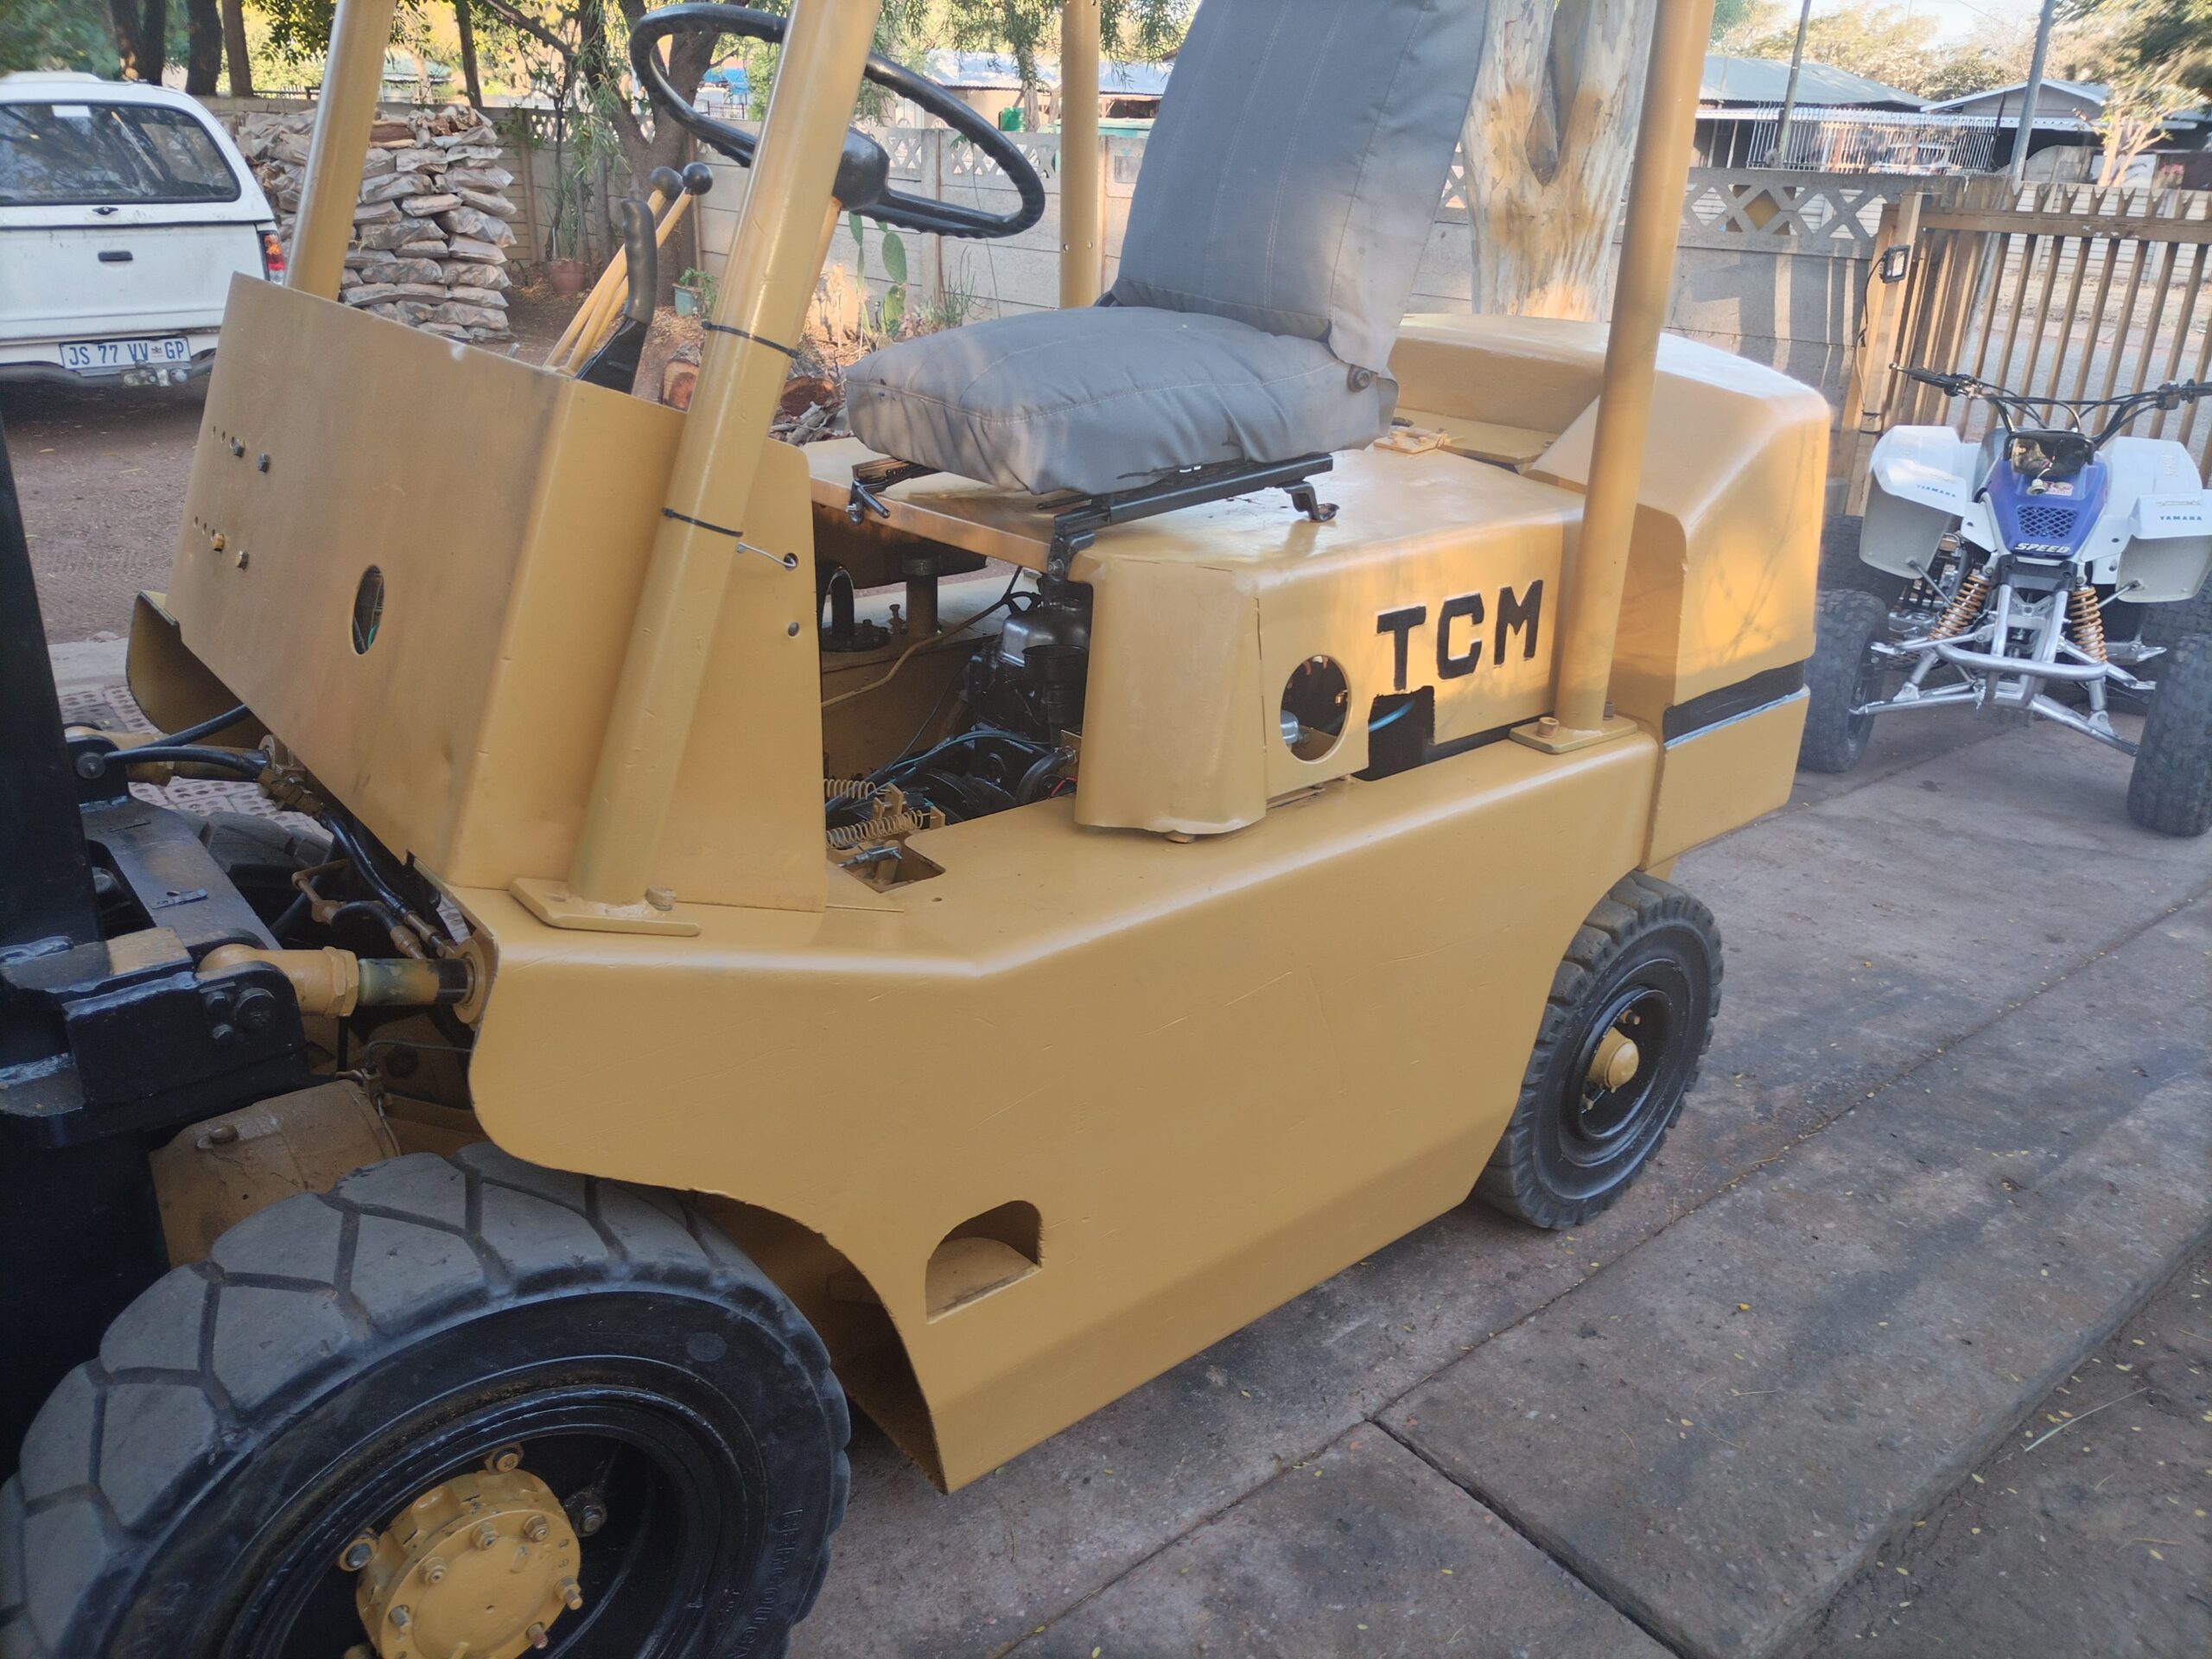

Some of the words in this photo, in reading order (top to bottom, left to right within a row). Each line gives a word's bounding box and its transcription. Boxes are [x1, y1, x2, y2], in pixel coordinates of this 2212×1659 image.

[69, 346, 90, 365] JS
[98, 345, 118, 364] 77
[127, 343, 149, 362] VV
[164, 340, 184, 359] GP
[2015, 543, 2070, 553] SPEED
[1376, 579, 1544, 691] TCM
